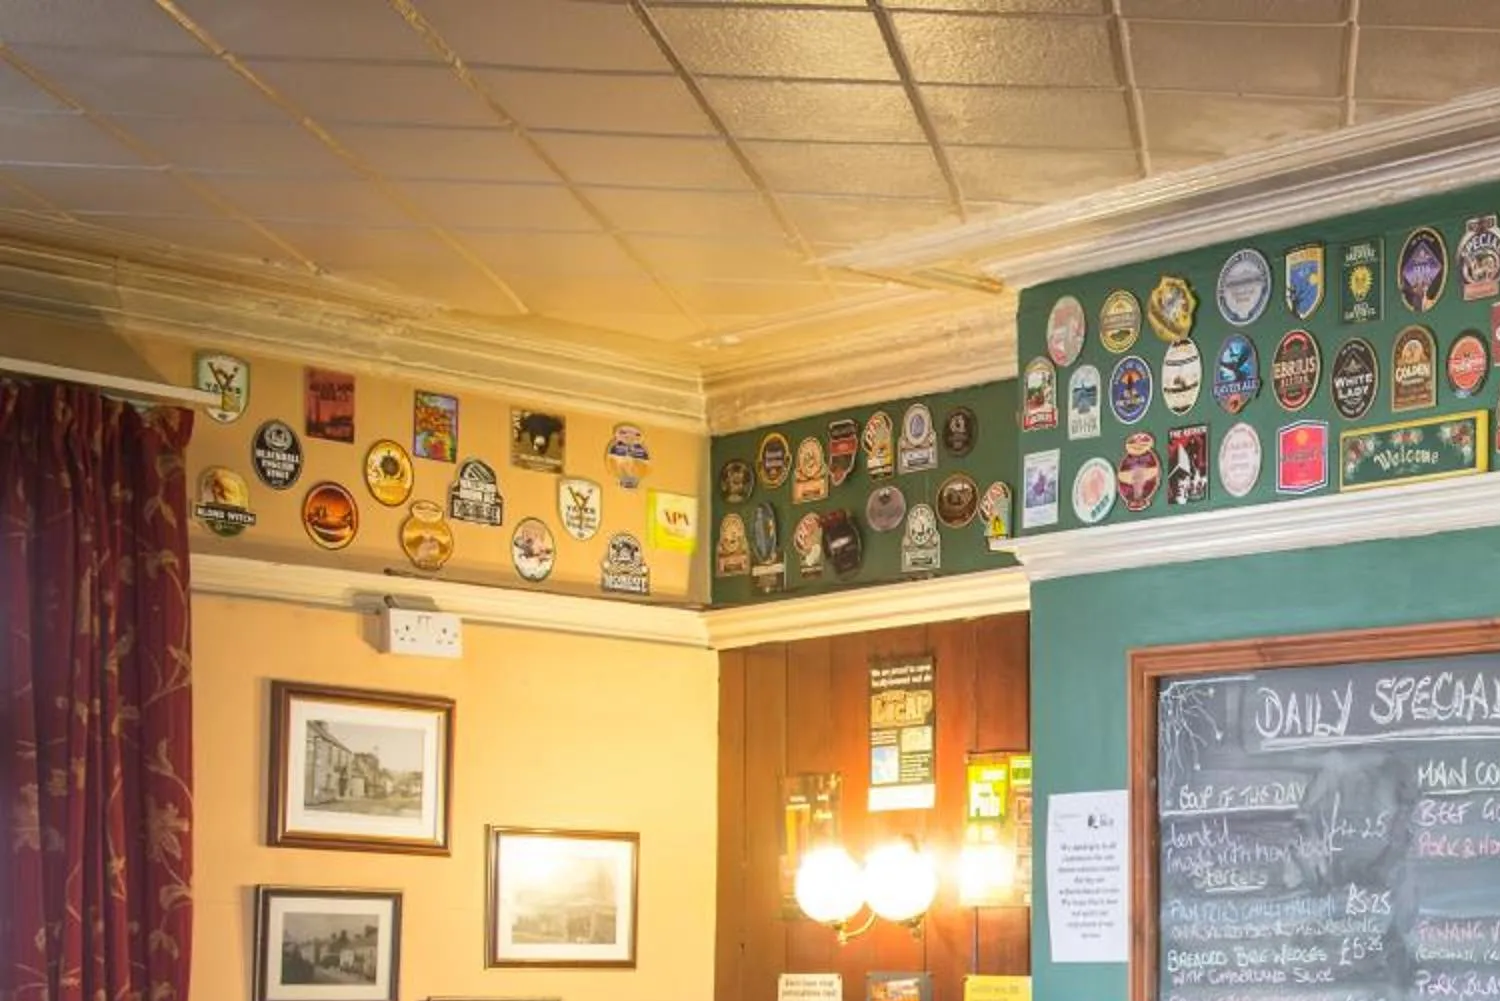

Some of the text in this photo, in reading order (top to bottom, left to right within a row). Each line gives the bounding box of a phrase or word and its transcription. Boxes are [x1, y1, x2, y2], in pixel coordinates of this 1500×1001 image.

[1374, 448, 1439, 471] Welcome
[1255, 679, 1353, 738] DAILY
[1273, 782, 1307, 802] DAY
